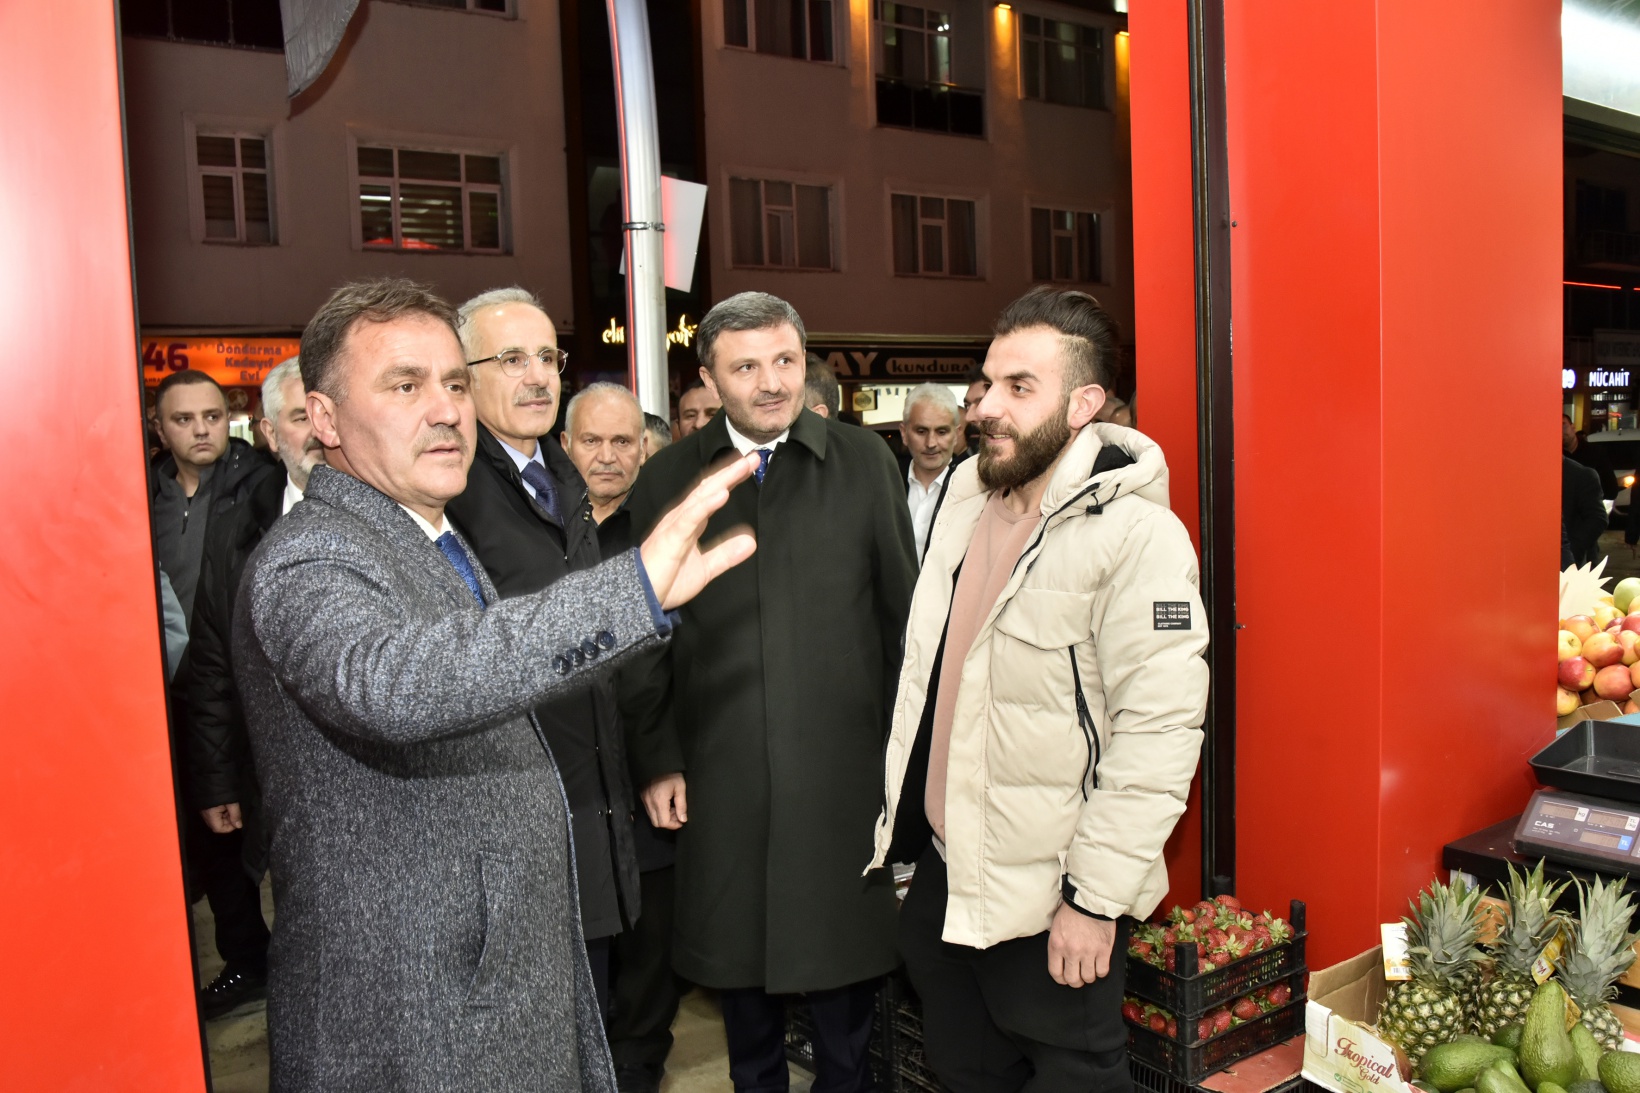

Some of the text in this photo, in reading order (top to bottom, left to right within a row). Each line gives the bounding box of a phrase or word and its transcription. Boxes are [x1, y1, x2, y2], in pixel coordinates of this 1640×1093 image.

[143, 342, 189, 372] 46
[217, 343, 282, 355] Dondurma
[1589, 368, 1630, 387] MÜCAHİT
[1535, 820, 1554, 829] CAS
[1333, 1037, 1395, 1079] Tropical
[1358, 1065, 1380, 1085] Gold
